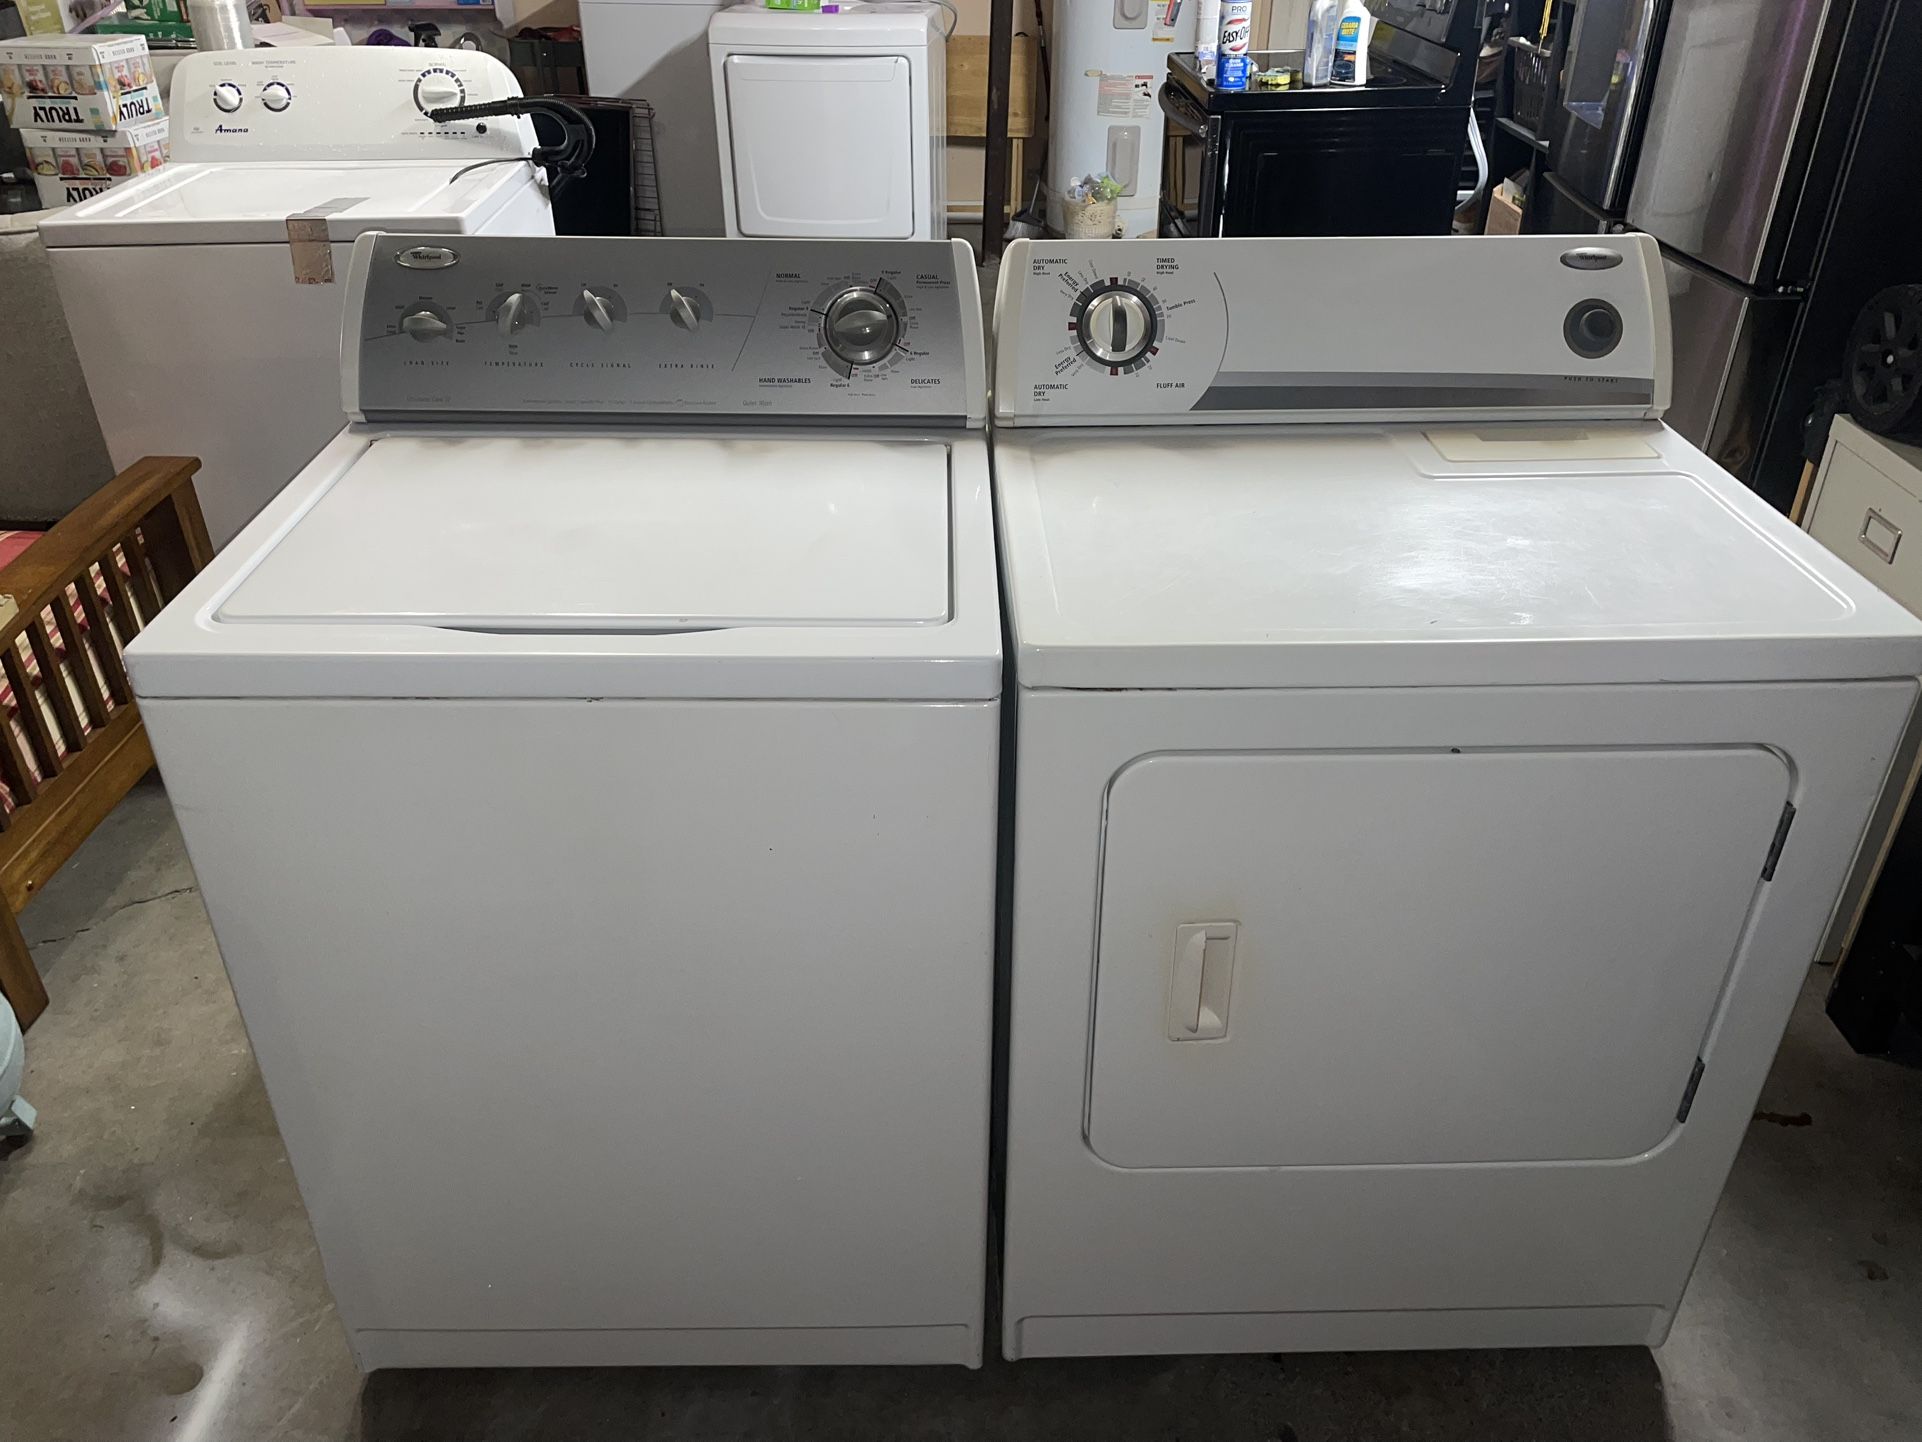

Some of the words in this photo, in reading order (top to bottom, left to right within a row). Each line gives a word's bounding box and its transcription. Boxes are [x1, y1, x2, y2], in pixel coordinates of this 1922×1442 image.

[1231, 5, 1248, 13] PRO
[33, 105, 84, 124] TRULY
[118, 97, 152, 122] TRULY
[215, 124, 249, 134] Amana
[412, 253, 442, 261] Whirlpool
